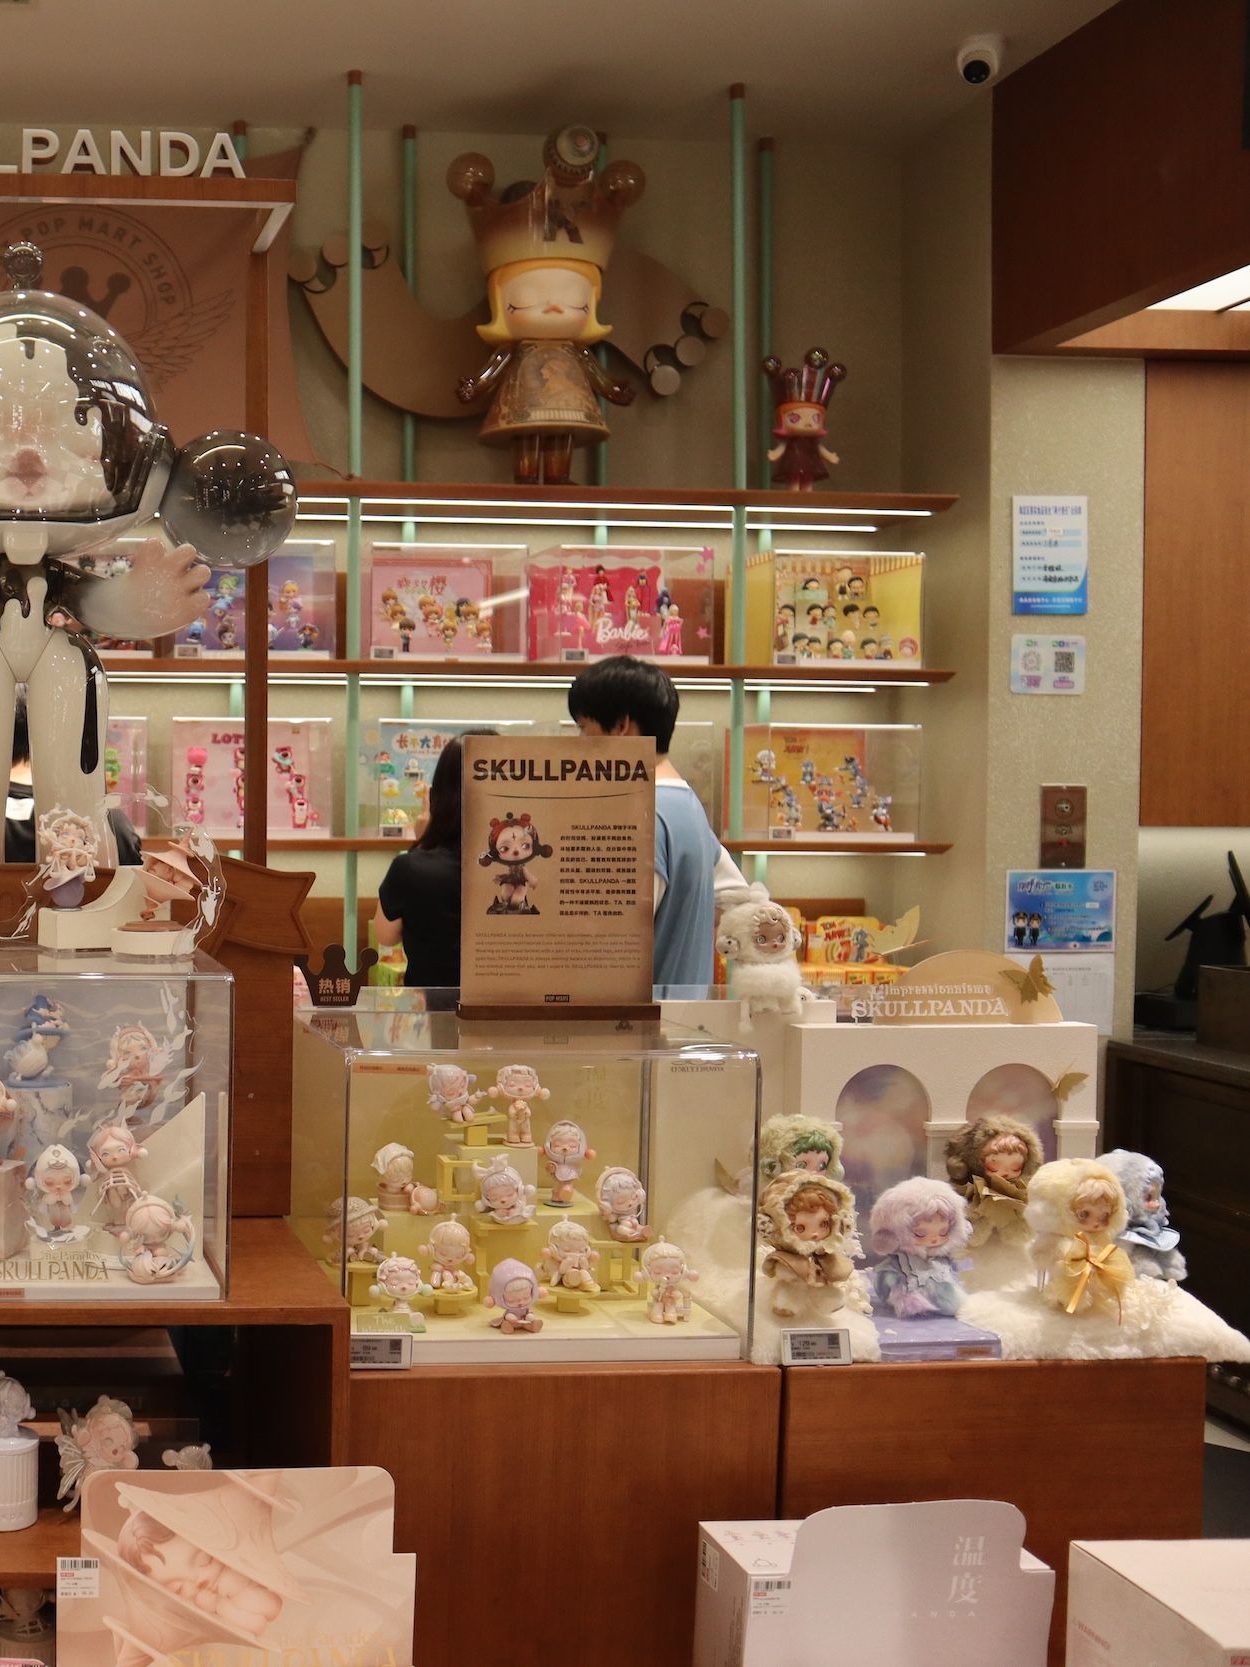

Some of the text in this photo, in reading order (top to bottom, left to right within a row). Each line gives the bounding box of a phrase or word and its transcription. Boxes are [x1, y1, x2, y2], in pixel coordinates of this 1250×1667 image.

[19, 219, 64, 239] POP
[78, 217, 143, 250] MART
[141, 252, 178, 307] SHOP
[596, 618, 648, 642] Barbie
[211, 733, 245, 744] LOT
[473, 759, 649, 782] SKULLPANDA
[318, 978, 351, 994] 热销
[852, 997, 1008, 1018] SKULLPANDA
[947, 1535, 987, 1604] 温度
